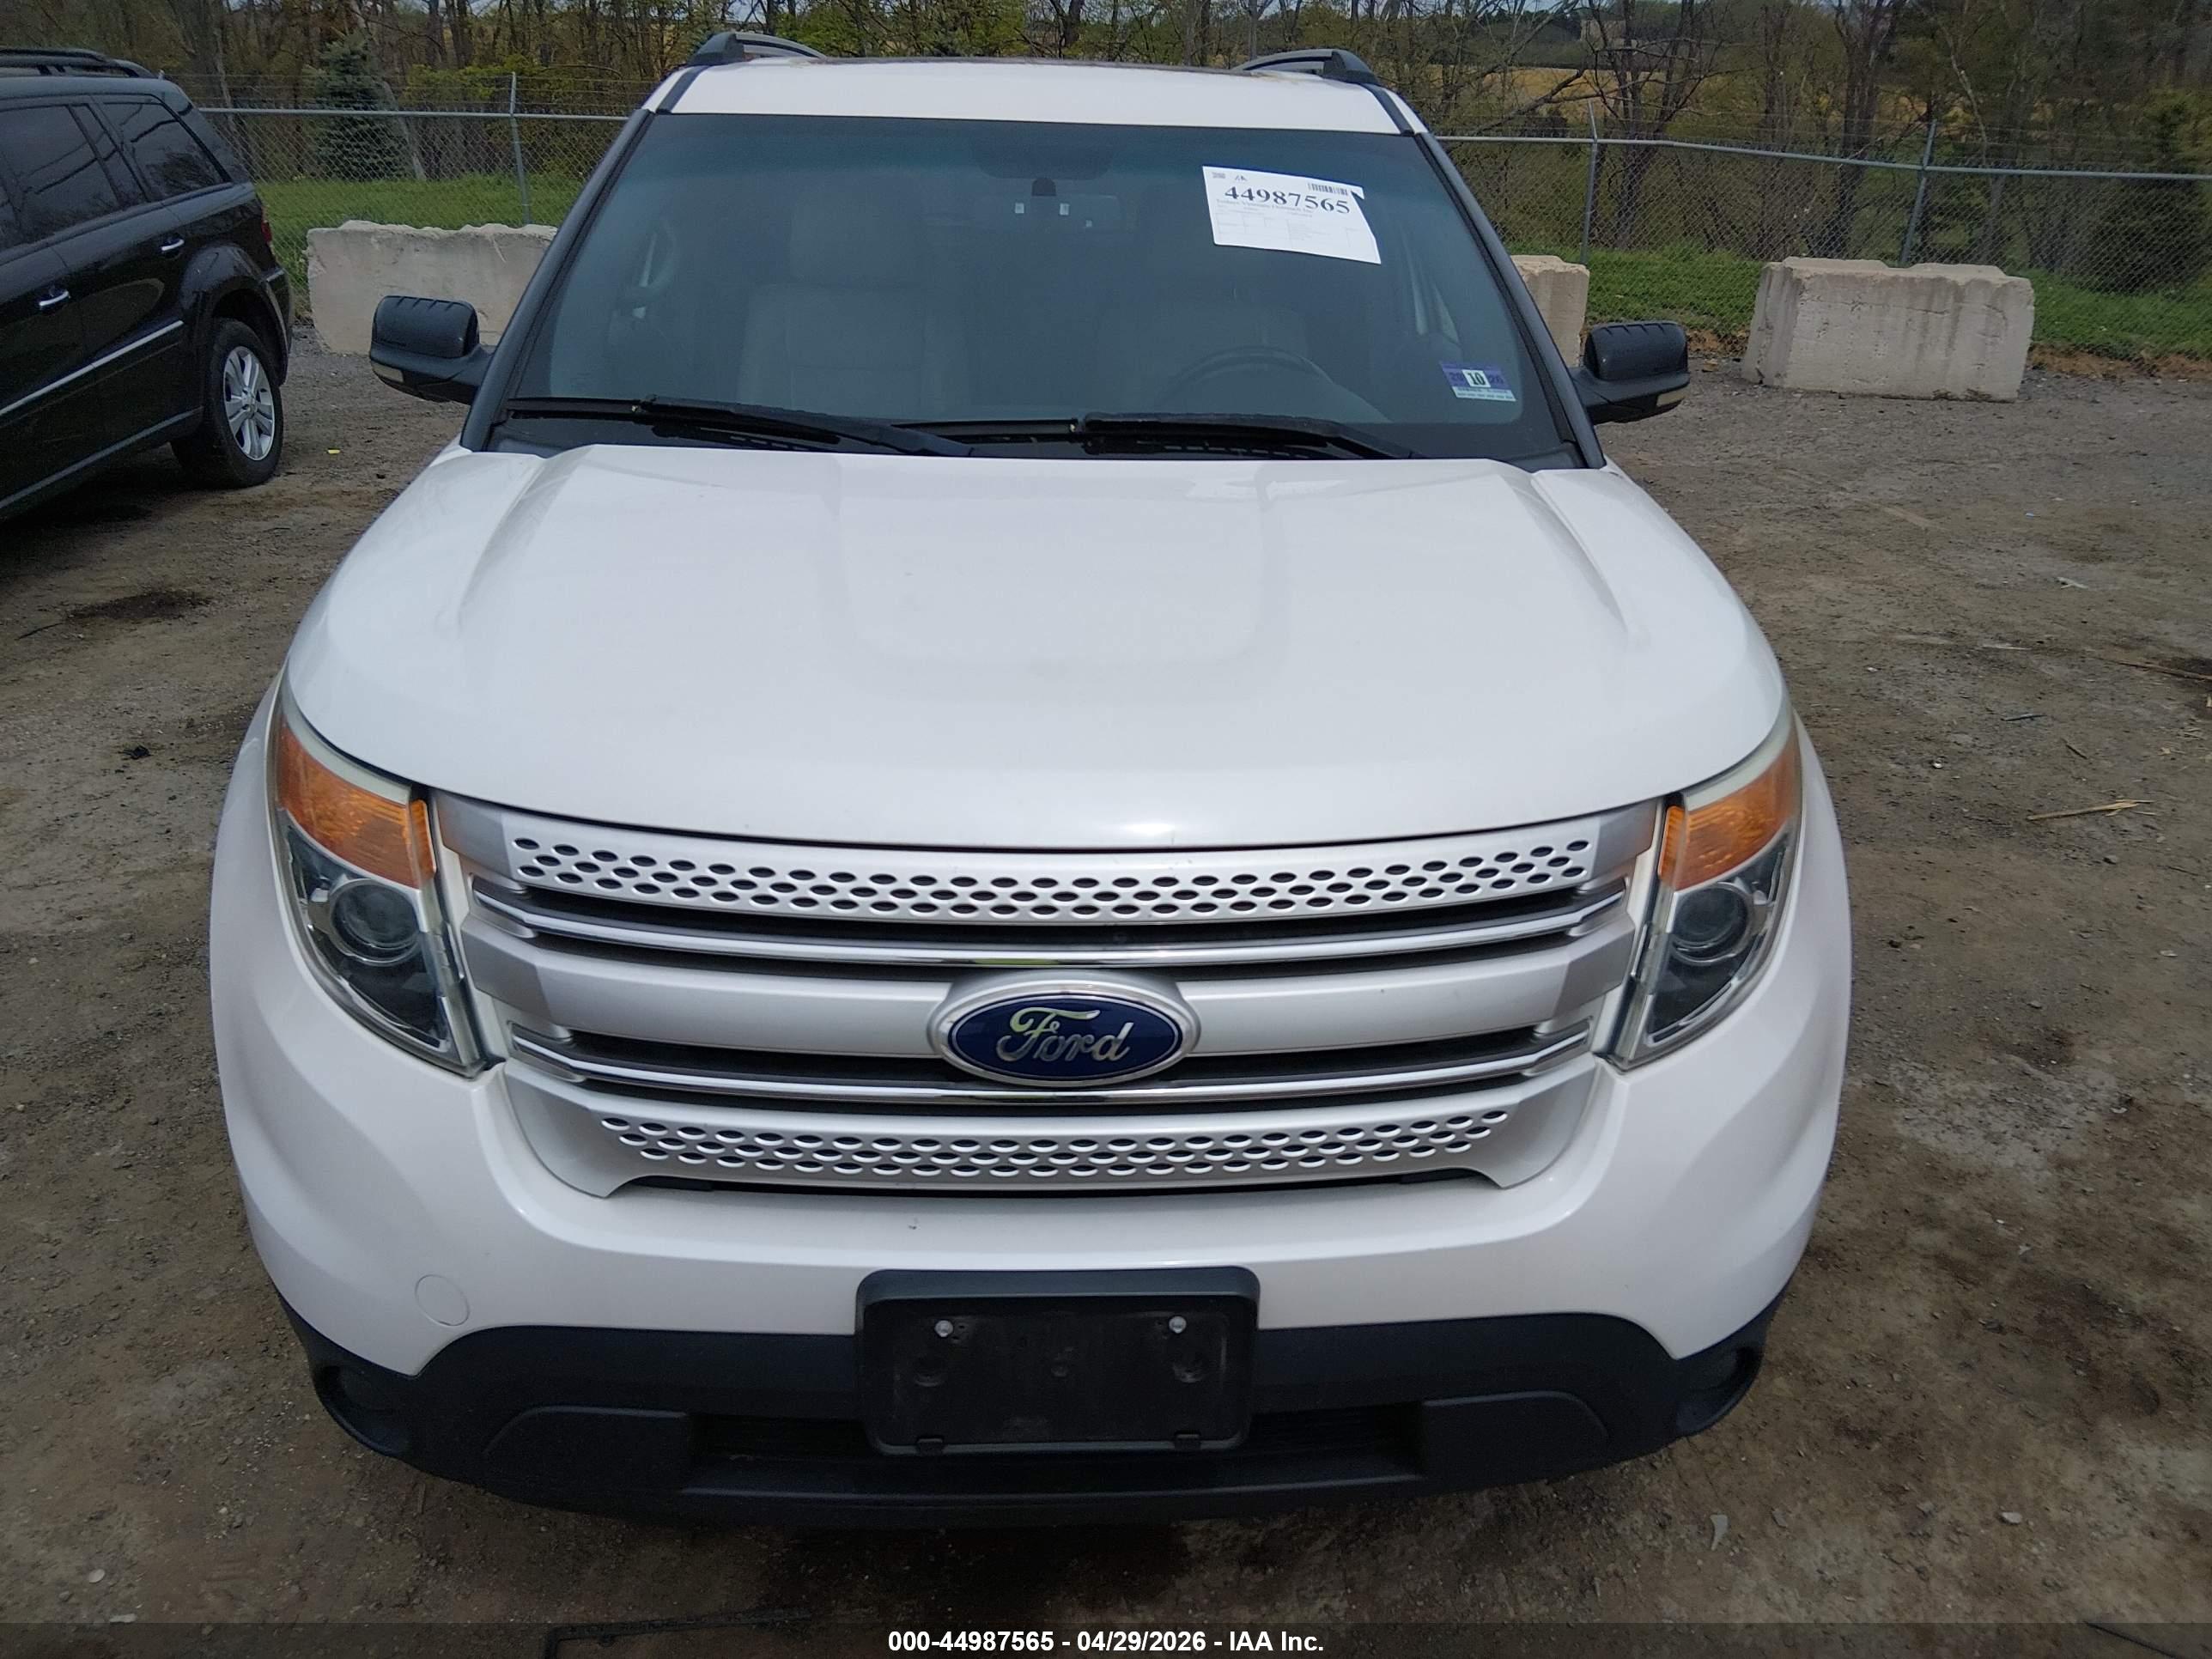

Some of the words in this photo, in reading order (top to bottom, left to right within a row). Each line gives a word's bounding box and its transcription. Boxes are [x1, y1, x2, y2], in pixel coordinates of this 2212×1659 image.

[1224, 186, 1351, 214] 44987565
[1467, 372, 1486, 386] 10
[996, 1007, 1134, 1062] Ford
